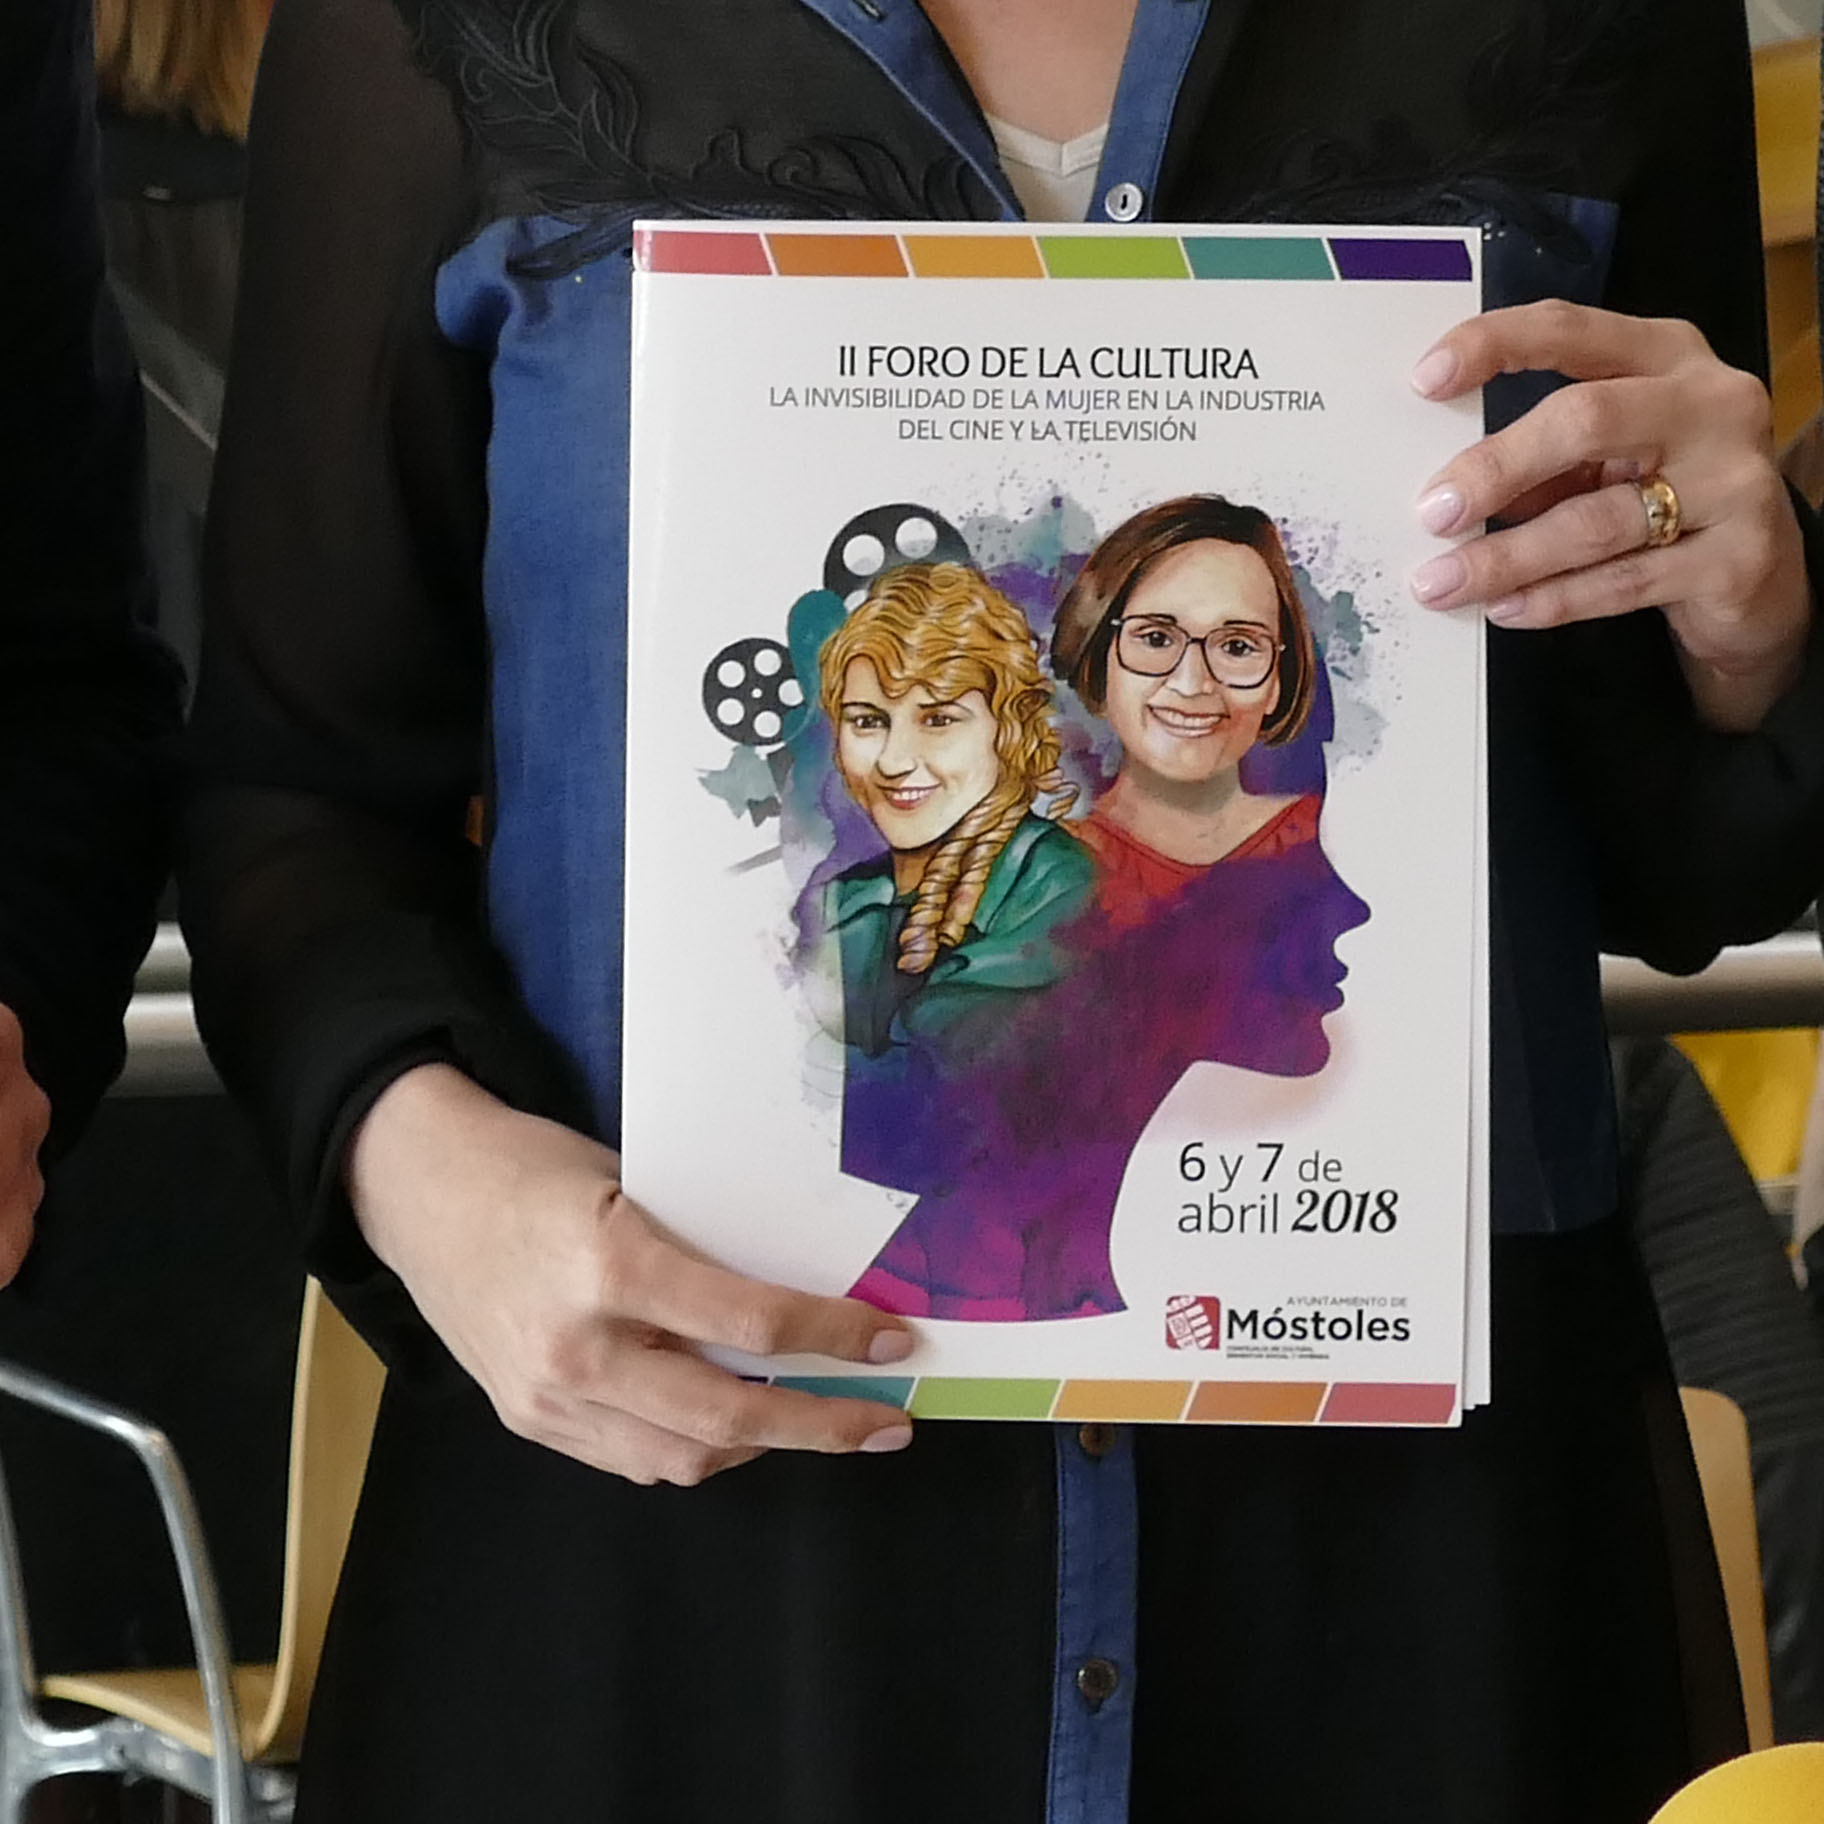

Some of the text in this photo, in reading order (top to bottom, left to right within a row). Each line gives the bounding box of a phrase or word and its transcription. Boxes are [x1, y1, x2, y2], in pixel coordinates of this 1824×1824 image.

[839, 345, 1259, 379] II FORO DE LA CULTURA
[770, 386, 1325, 414] LA INVISIBILIDAD DE LA MUJER EN LA INDUSTRIA
[899, 416, 1197, 441] DEL CINE Y LA TELEVISIÓN
[1180, 1142, 1342, 1193] 6 y 7 de
[1178, 1189, 1399, 1234] abril 2018
[1286, 1295, 1407, 1307] AYUNTAMIENTO DE
[1227, 1307, 1410, 1341] Móstoles
